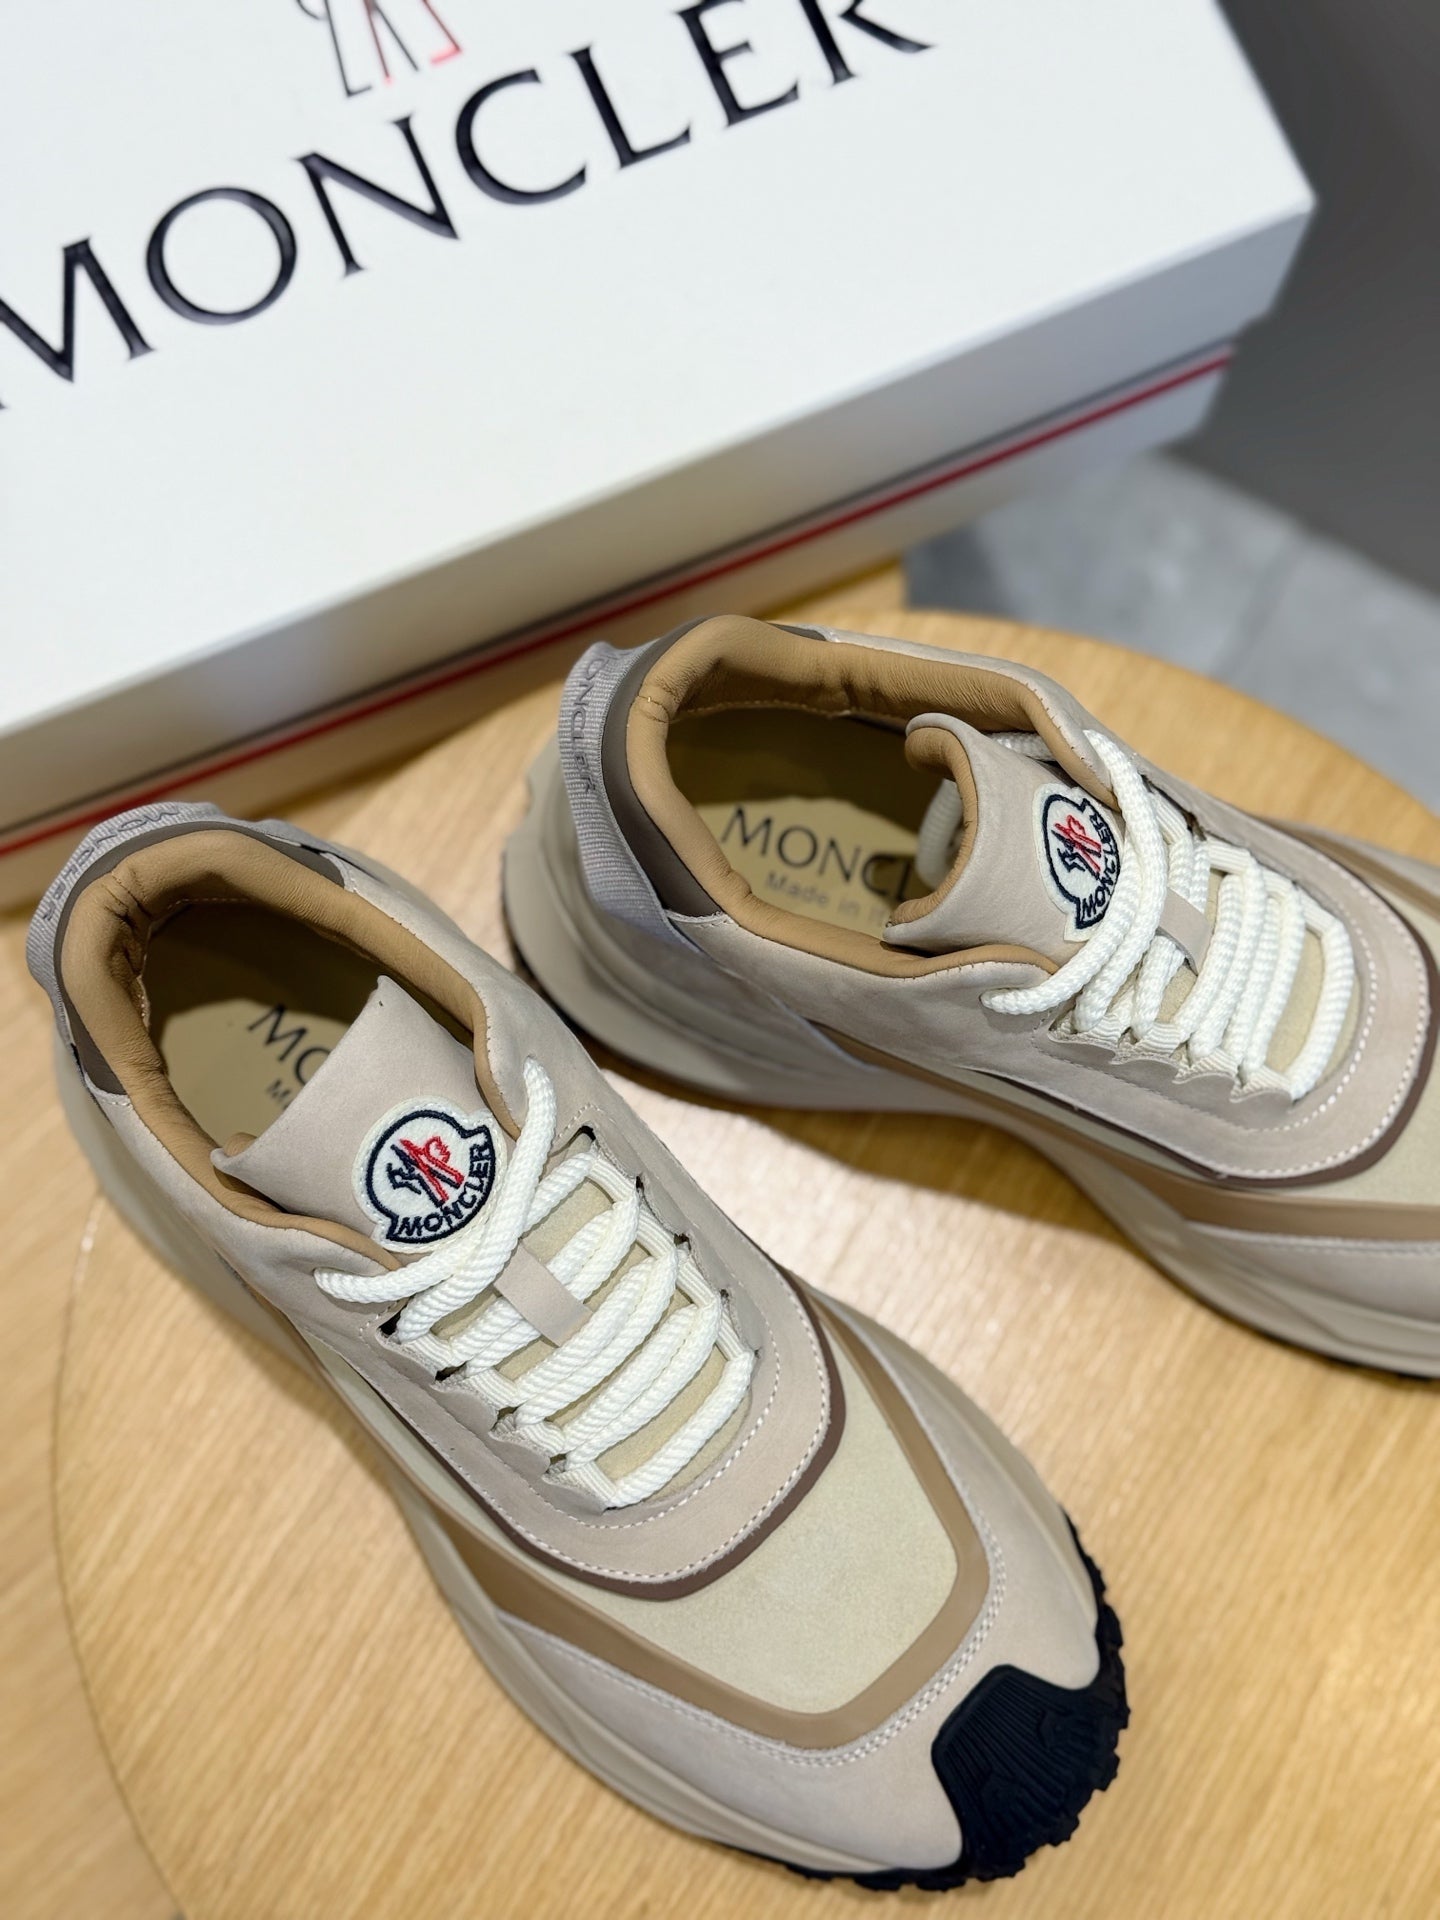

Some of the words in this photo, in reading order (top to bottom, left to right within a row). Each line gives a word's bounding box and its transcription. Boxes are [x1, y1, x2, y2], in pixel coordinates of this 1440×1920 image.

[765, 871, 830, 909] Made
[1082, 813, 1117, 920] MONCLER
[398, 1142, 492, 1237] MONCLER
